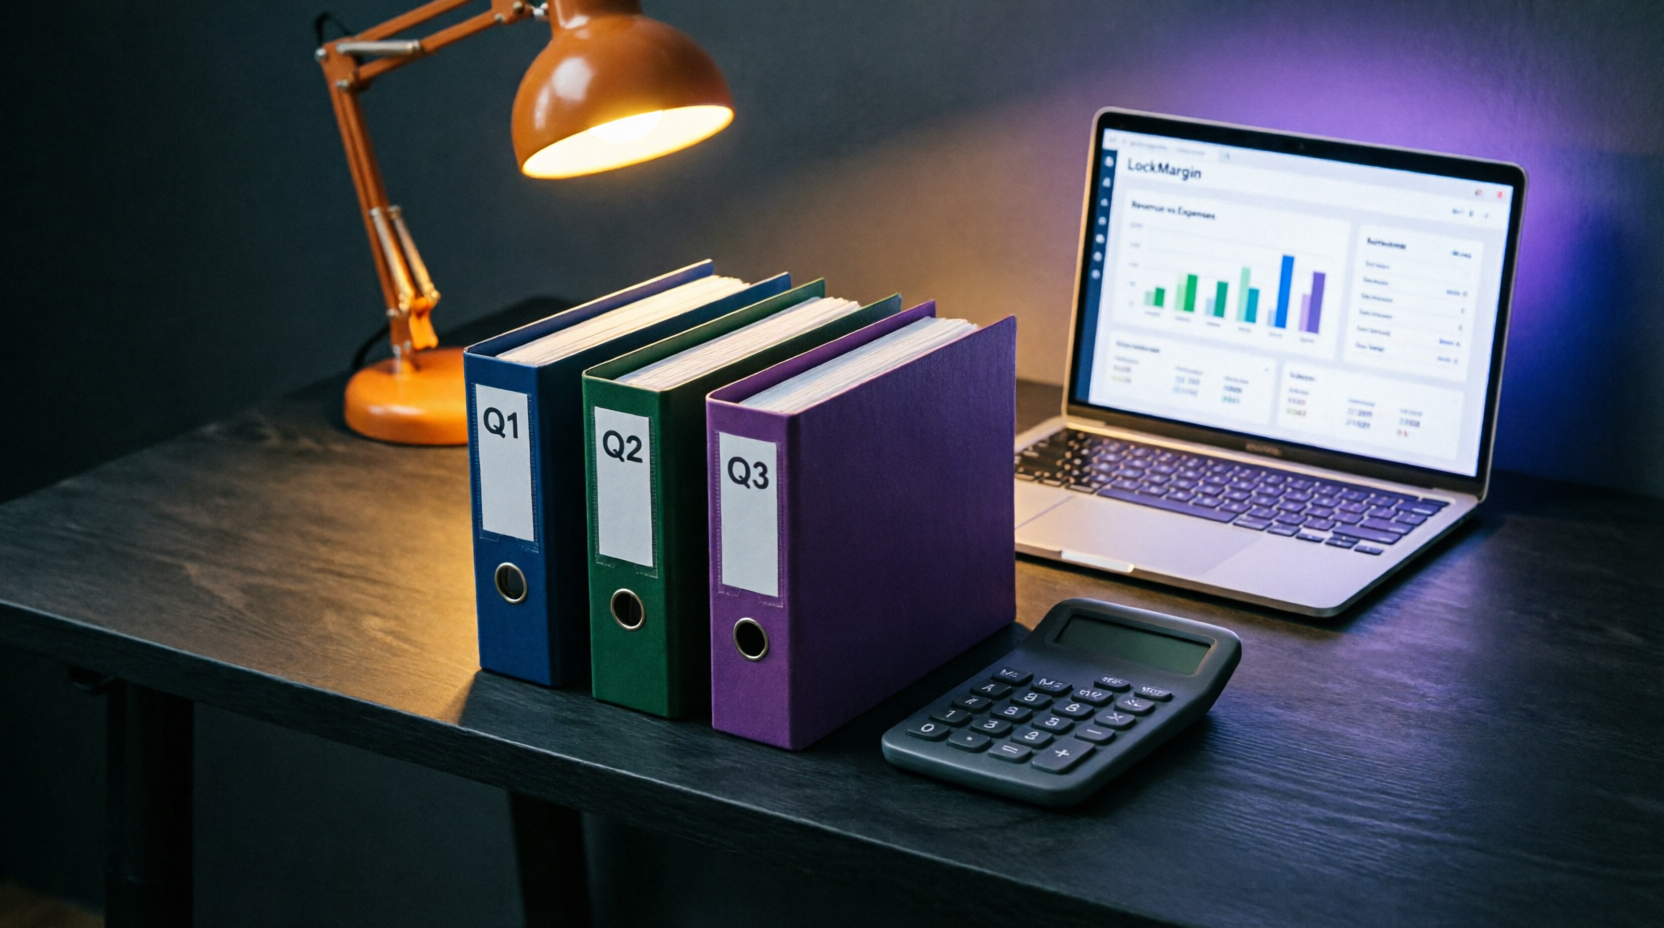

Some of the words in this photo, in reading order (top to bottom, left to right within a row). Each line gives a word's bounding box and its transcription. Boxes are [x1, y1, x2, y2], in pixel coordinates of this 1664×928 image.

[1127, 159, 1202, 181] LockMargin
[483, 407, 518, 439] Q1
[603, 430, 643, 463] Q2
[728, 456, 769, 489] Q3
